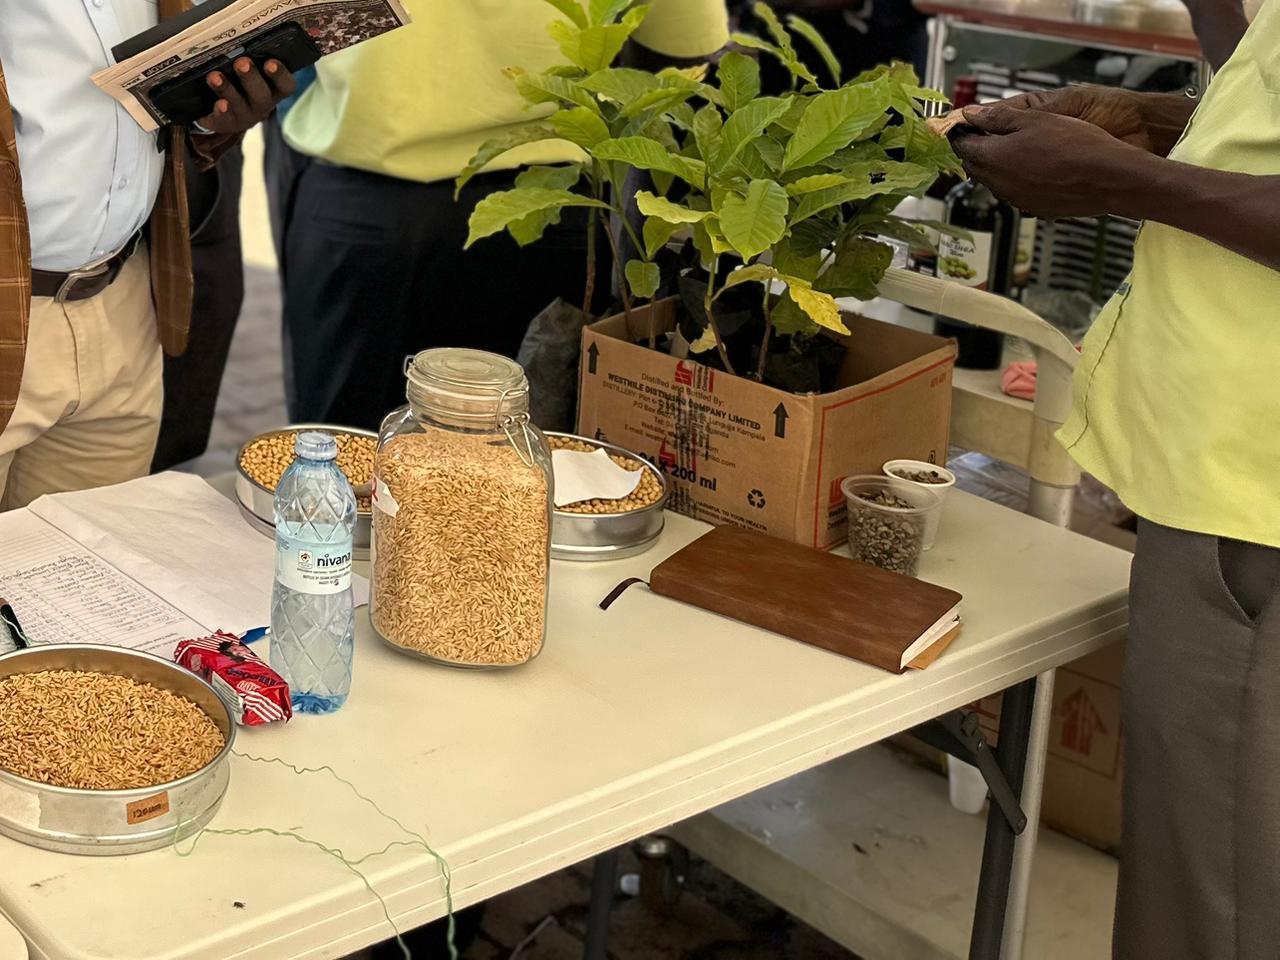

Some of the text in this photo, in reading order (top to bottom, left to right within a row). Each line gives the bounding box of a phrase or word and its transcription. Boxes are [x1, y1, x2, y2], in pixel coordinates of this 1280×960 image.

[607, 373, 645, 392] WESTNILE
[728, 413, 761, 430] LIMITED
[671, 467, 697, 483] 200
[699, 476, 718, 491] ml
